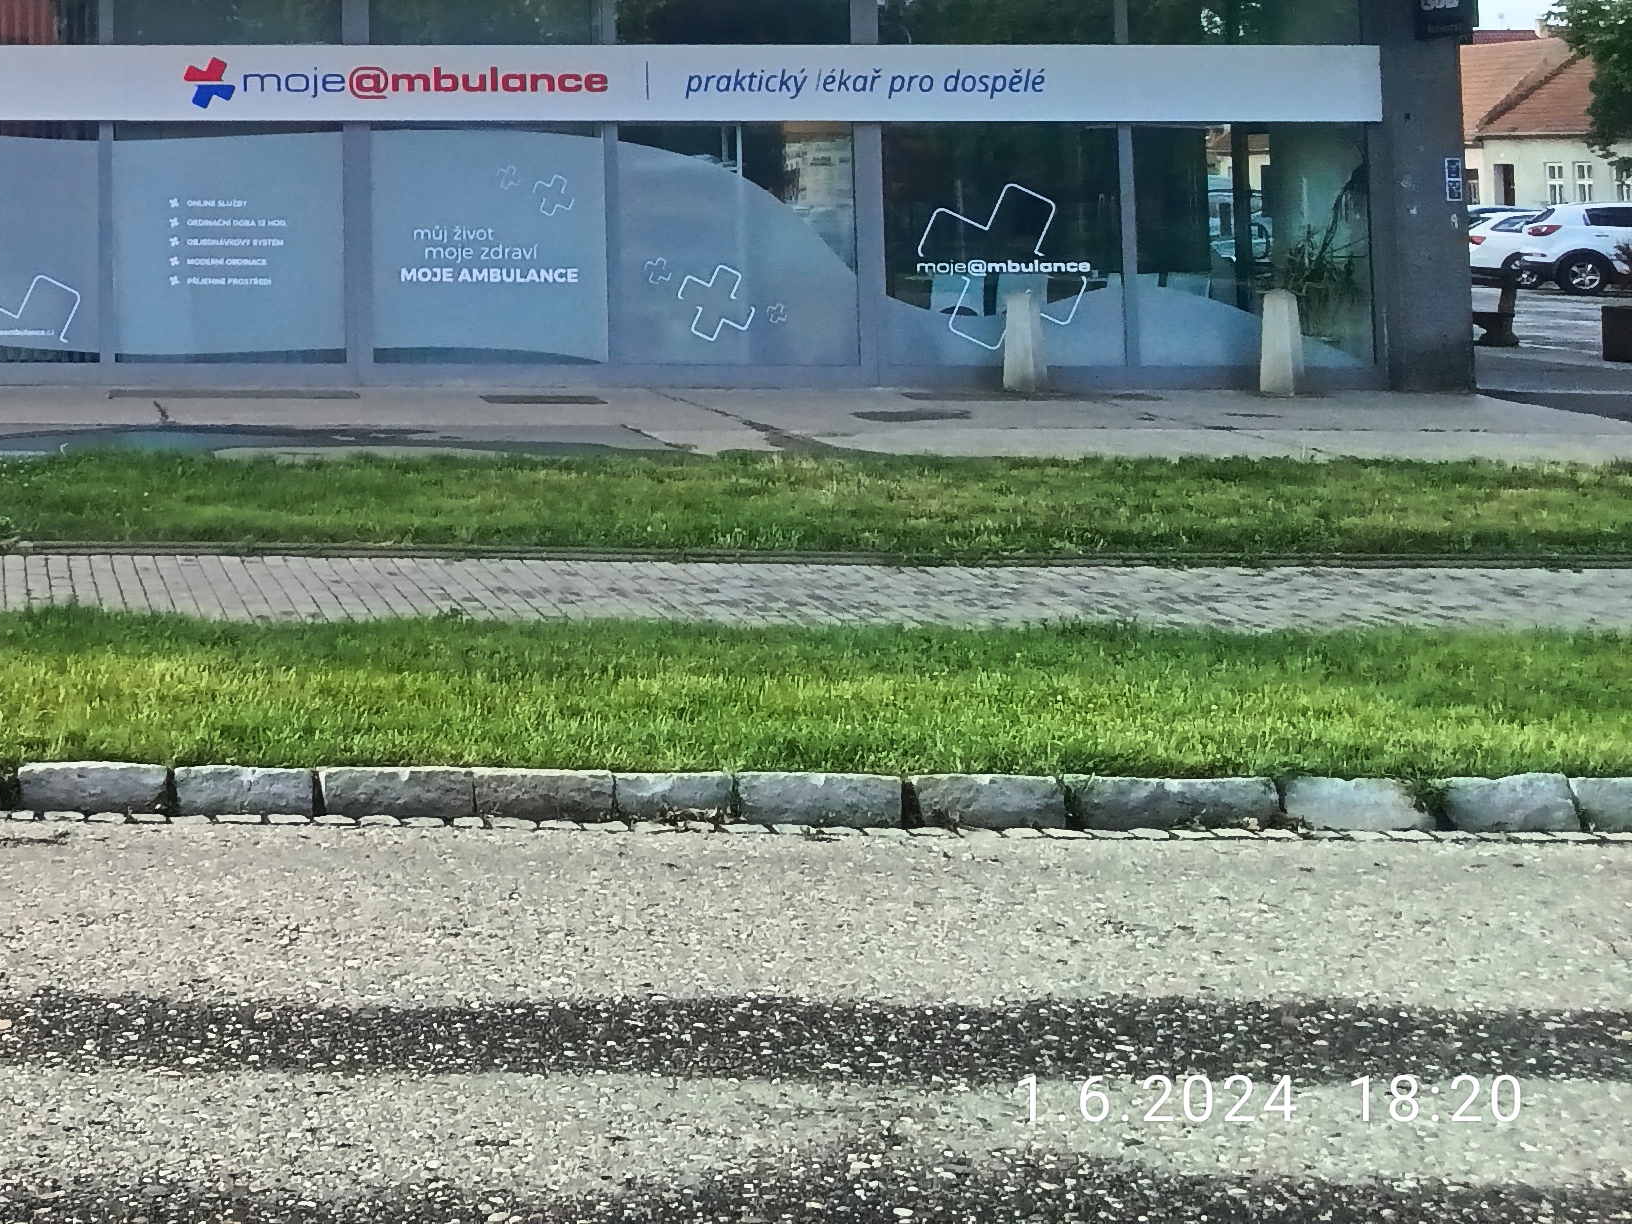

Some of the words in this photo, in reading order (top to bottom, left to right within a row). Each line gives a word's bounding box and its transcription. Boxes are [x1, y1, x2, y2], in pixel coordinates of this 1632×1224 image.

[243, 66, 609, 99] moje@mbulance
[685, 68, 808, 99] praktický
[815, 68, 883, 92] lékař
[888, 73, 933, 99] pro
[943, 68, 1046, 99] dospělé
[217, 199, 248, 207] SLUŽBY
[413, 225, 448, 243] můj
[453, 225, 494, 241] život
[425, 245, 474, 263] moje
[480, 243, 538, 260] zdraví
[400, 268, 454, 282] MOJE
[458, 268, 579, 283] AMBULANCE
[916, 259, 1091, 277] moje@mbulance
